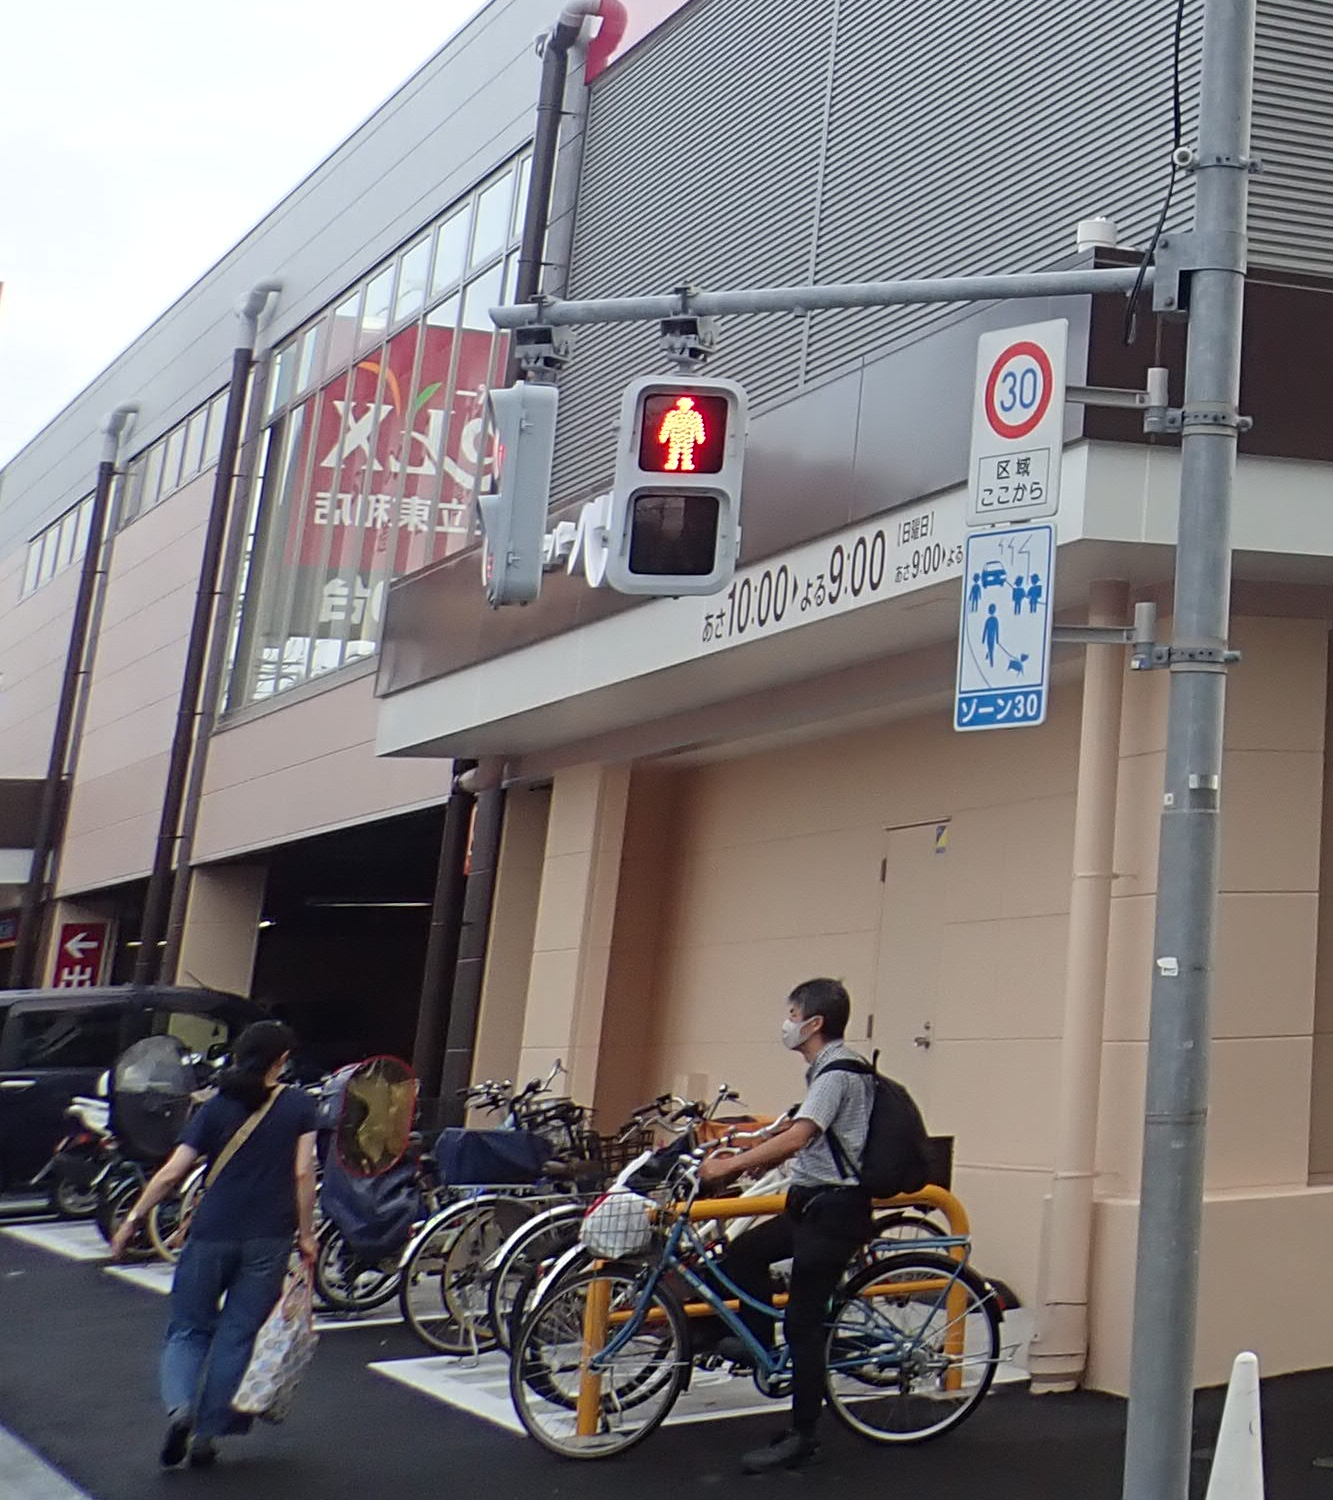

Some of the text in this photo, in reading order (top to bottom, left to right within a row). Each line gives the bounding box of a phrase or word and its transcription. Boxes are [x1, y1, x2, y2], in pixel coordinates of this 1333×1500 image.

[1000, 368, 1037, 412] 30
[997, 457, 1031, 479] 区域
[981, 482, 1043, 506] ここから
